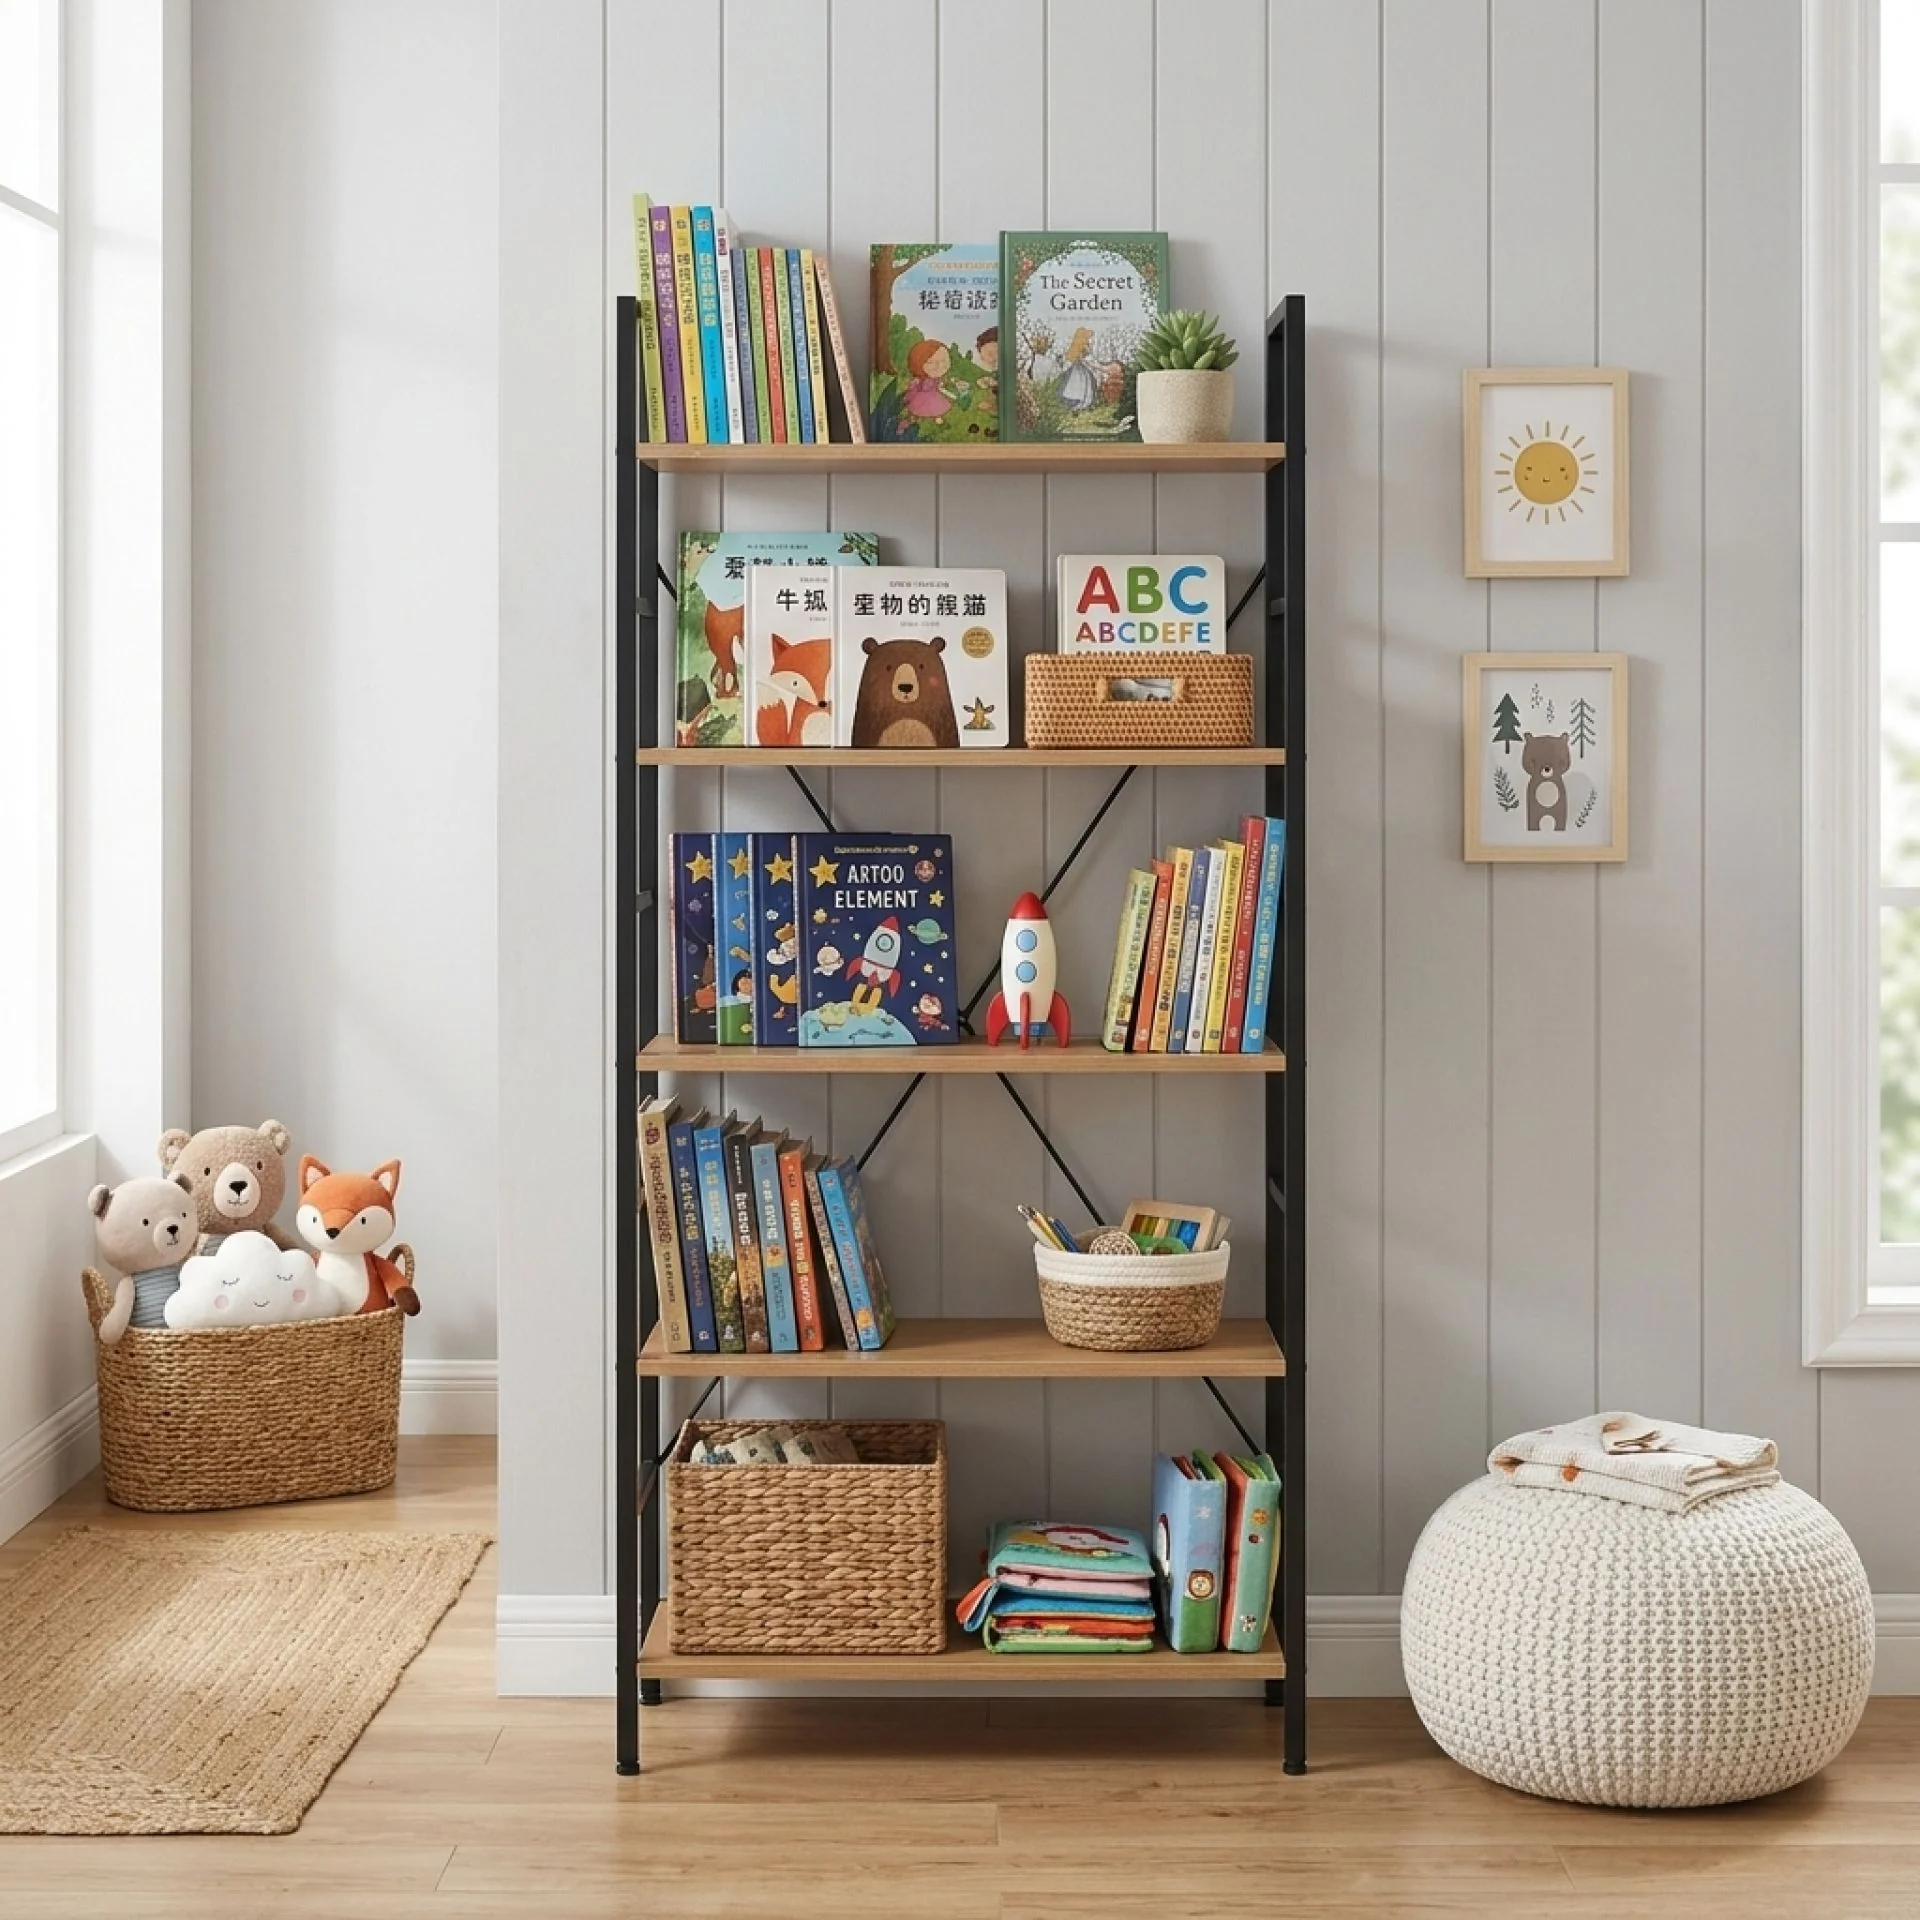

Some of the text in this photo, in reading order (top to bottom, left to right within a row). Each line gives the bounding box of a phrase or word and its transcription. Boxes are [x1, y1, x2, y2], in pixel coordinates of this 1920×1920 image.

[1040, 271, 1134, 290] The Secret
[1050, 292, 1123, 311] Garden
[1076, 565, 1209, 615] ABC
[1075, 622, 1211, 644] ABCDEFE
[847, 864, 905, 884] ARTOO
[835, 889, 919, 909] ELEMENT
